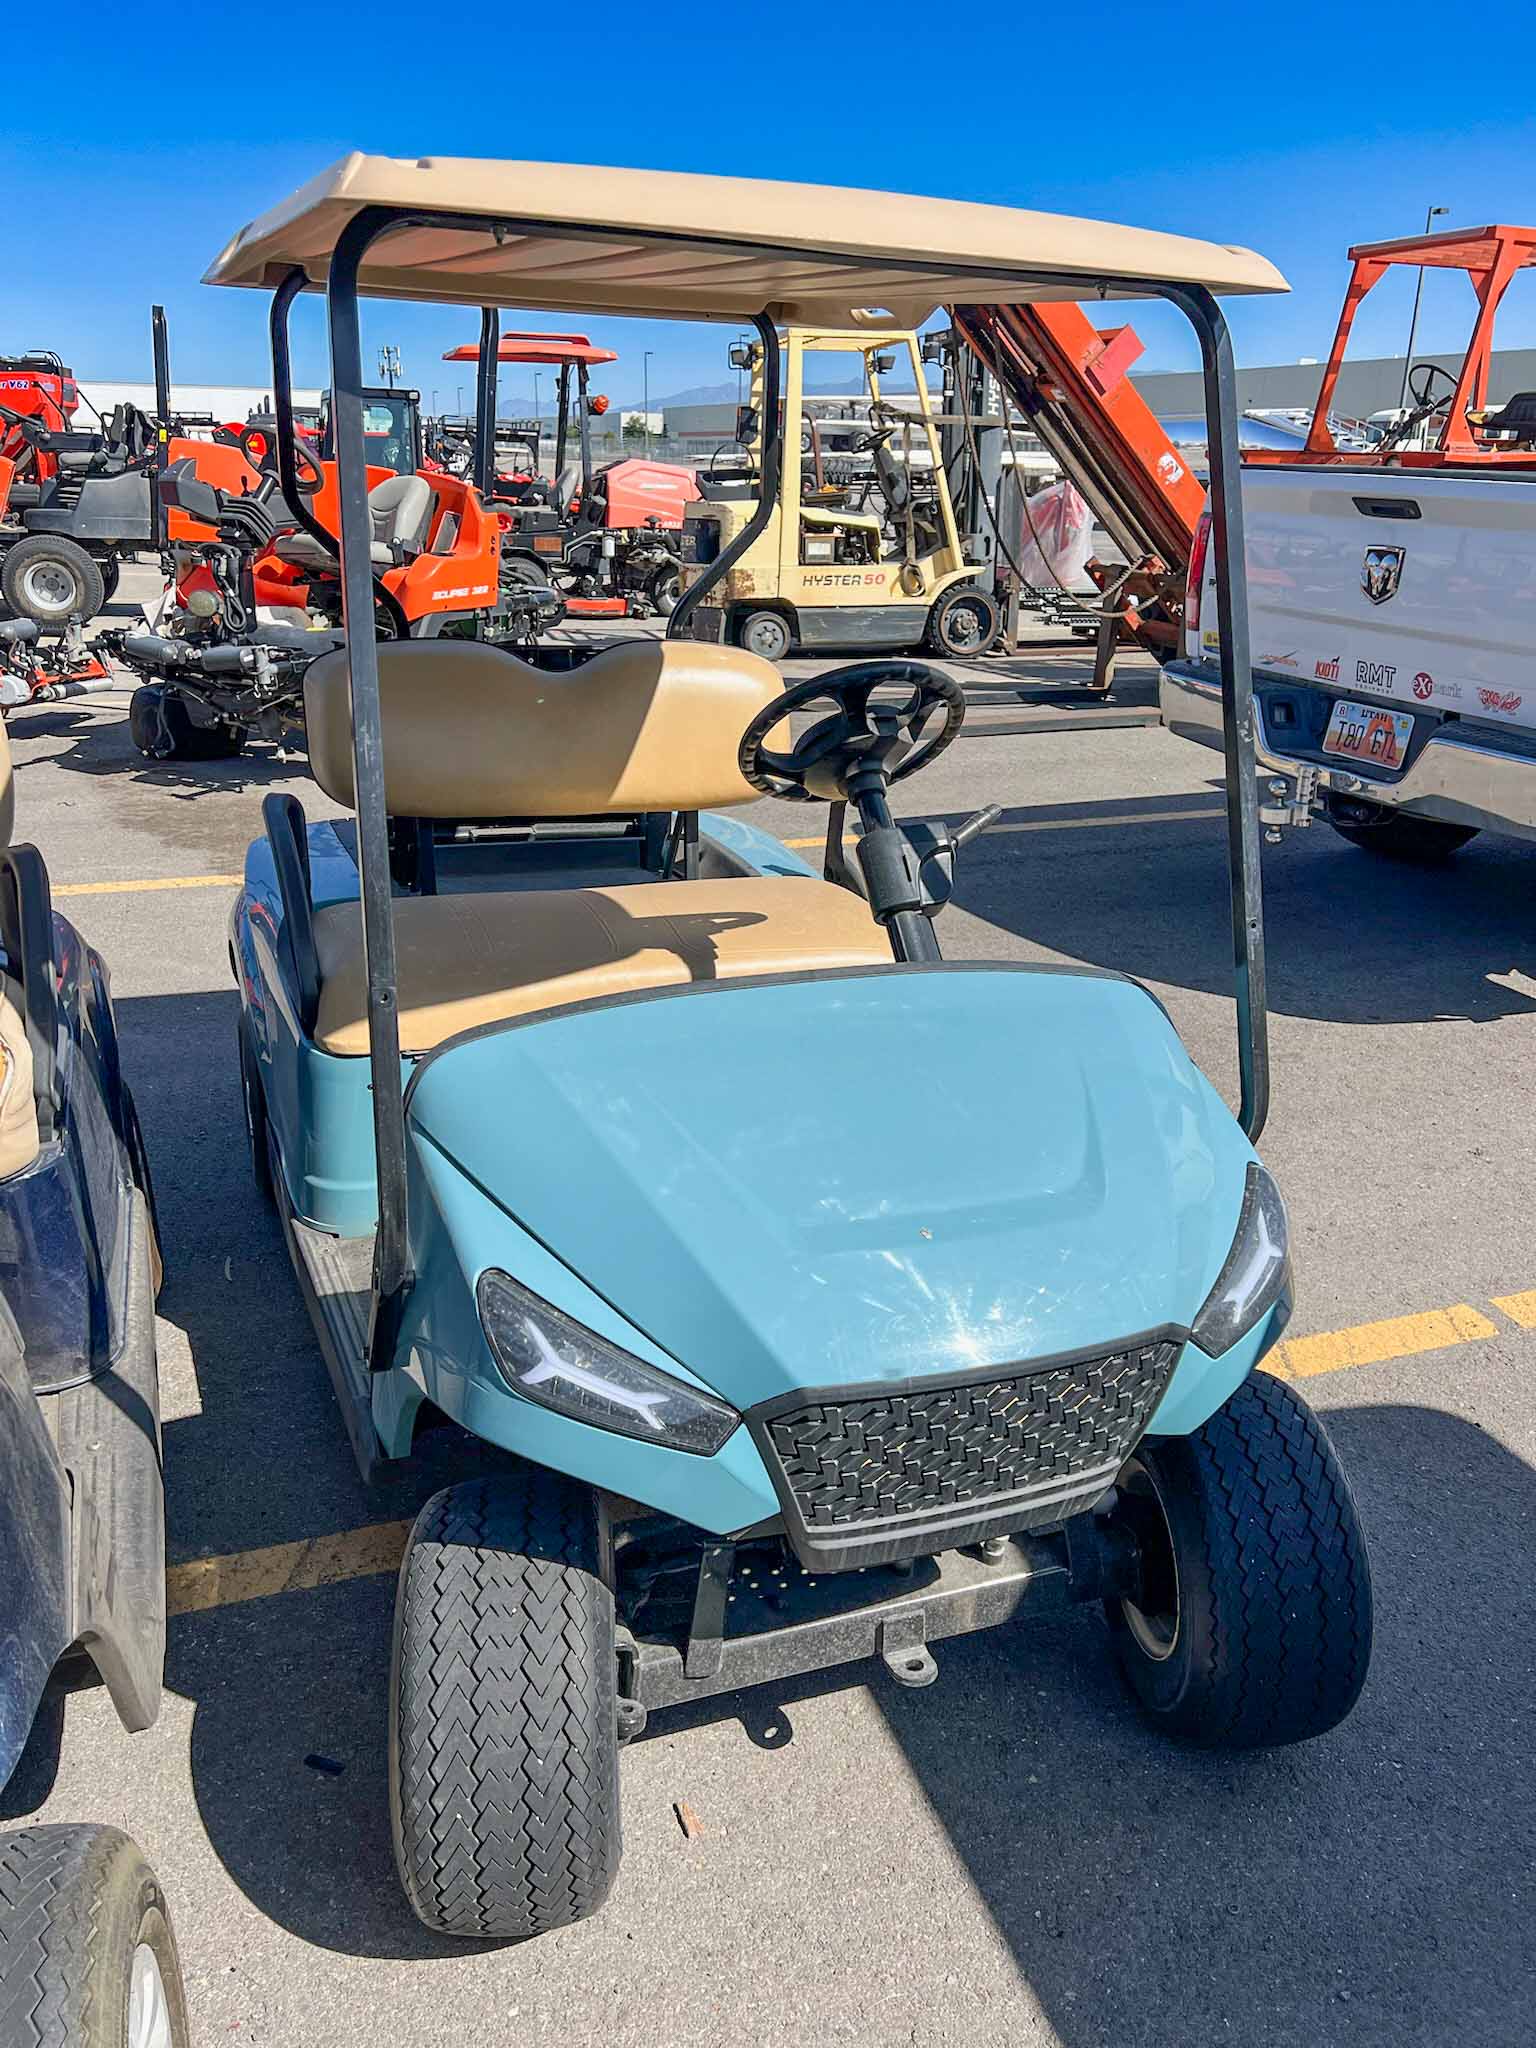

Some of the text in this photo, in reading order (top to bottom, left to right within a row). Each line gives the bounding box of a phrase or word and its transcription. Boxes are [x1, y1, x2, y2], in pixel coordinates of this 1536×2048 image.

[802, 573, 886, 586] HYSTER 50
[1315, 660, 1340, 679] KIOTI
[1356, 660, 1397, 688] RMT
[1360, 708, 1389, 722] UTAH
